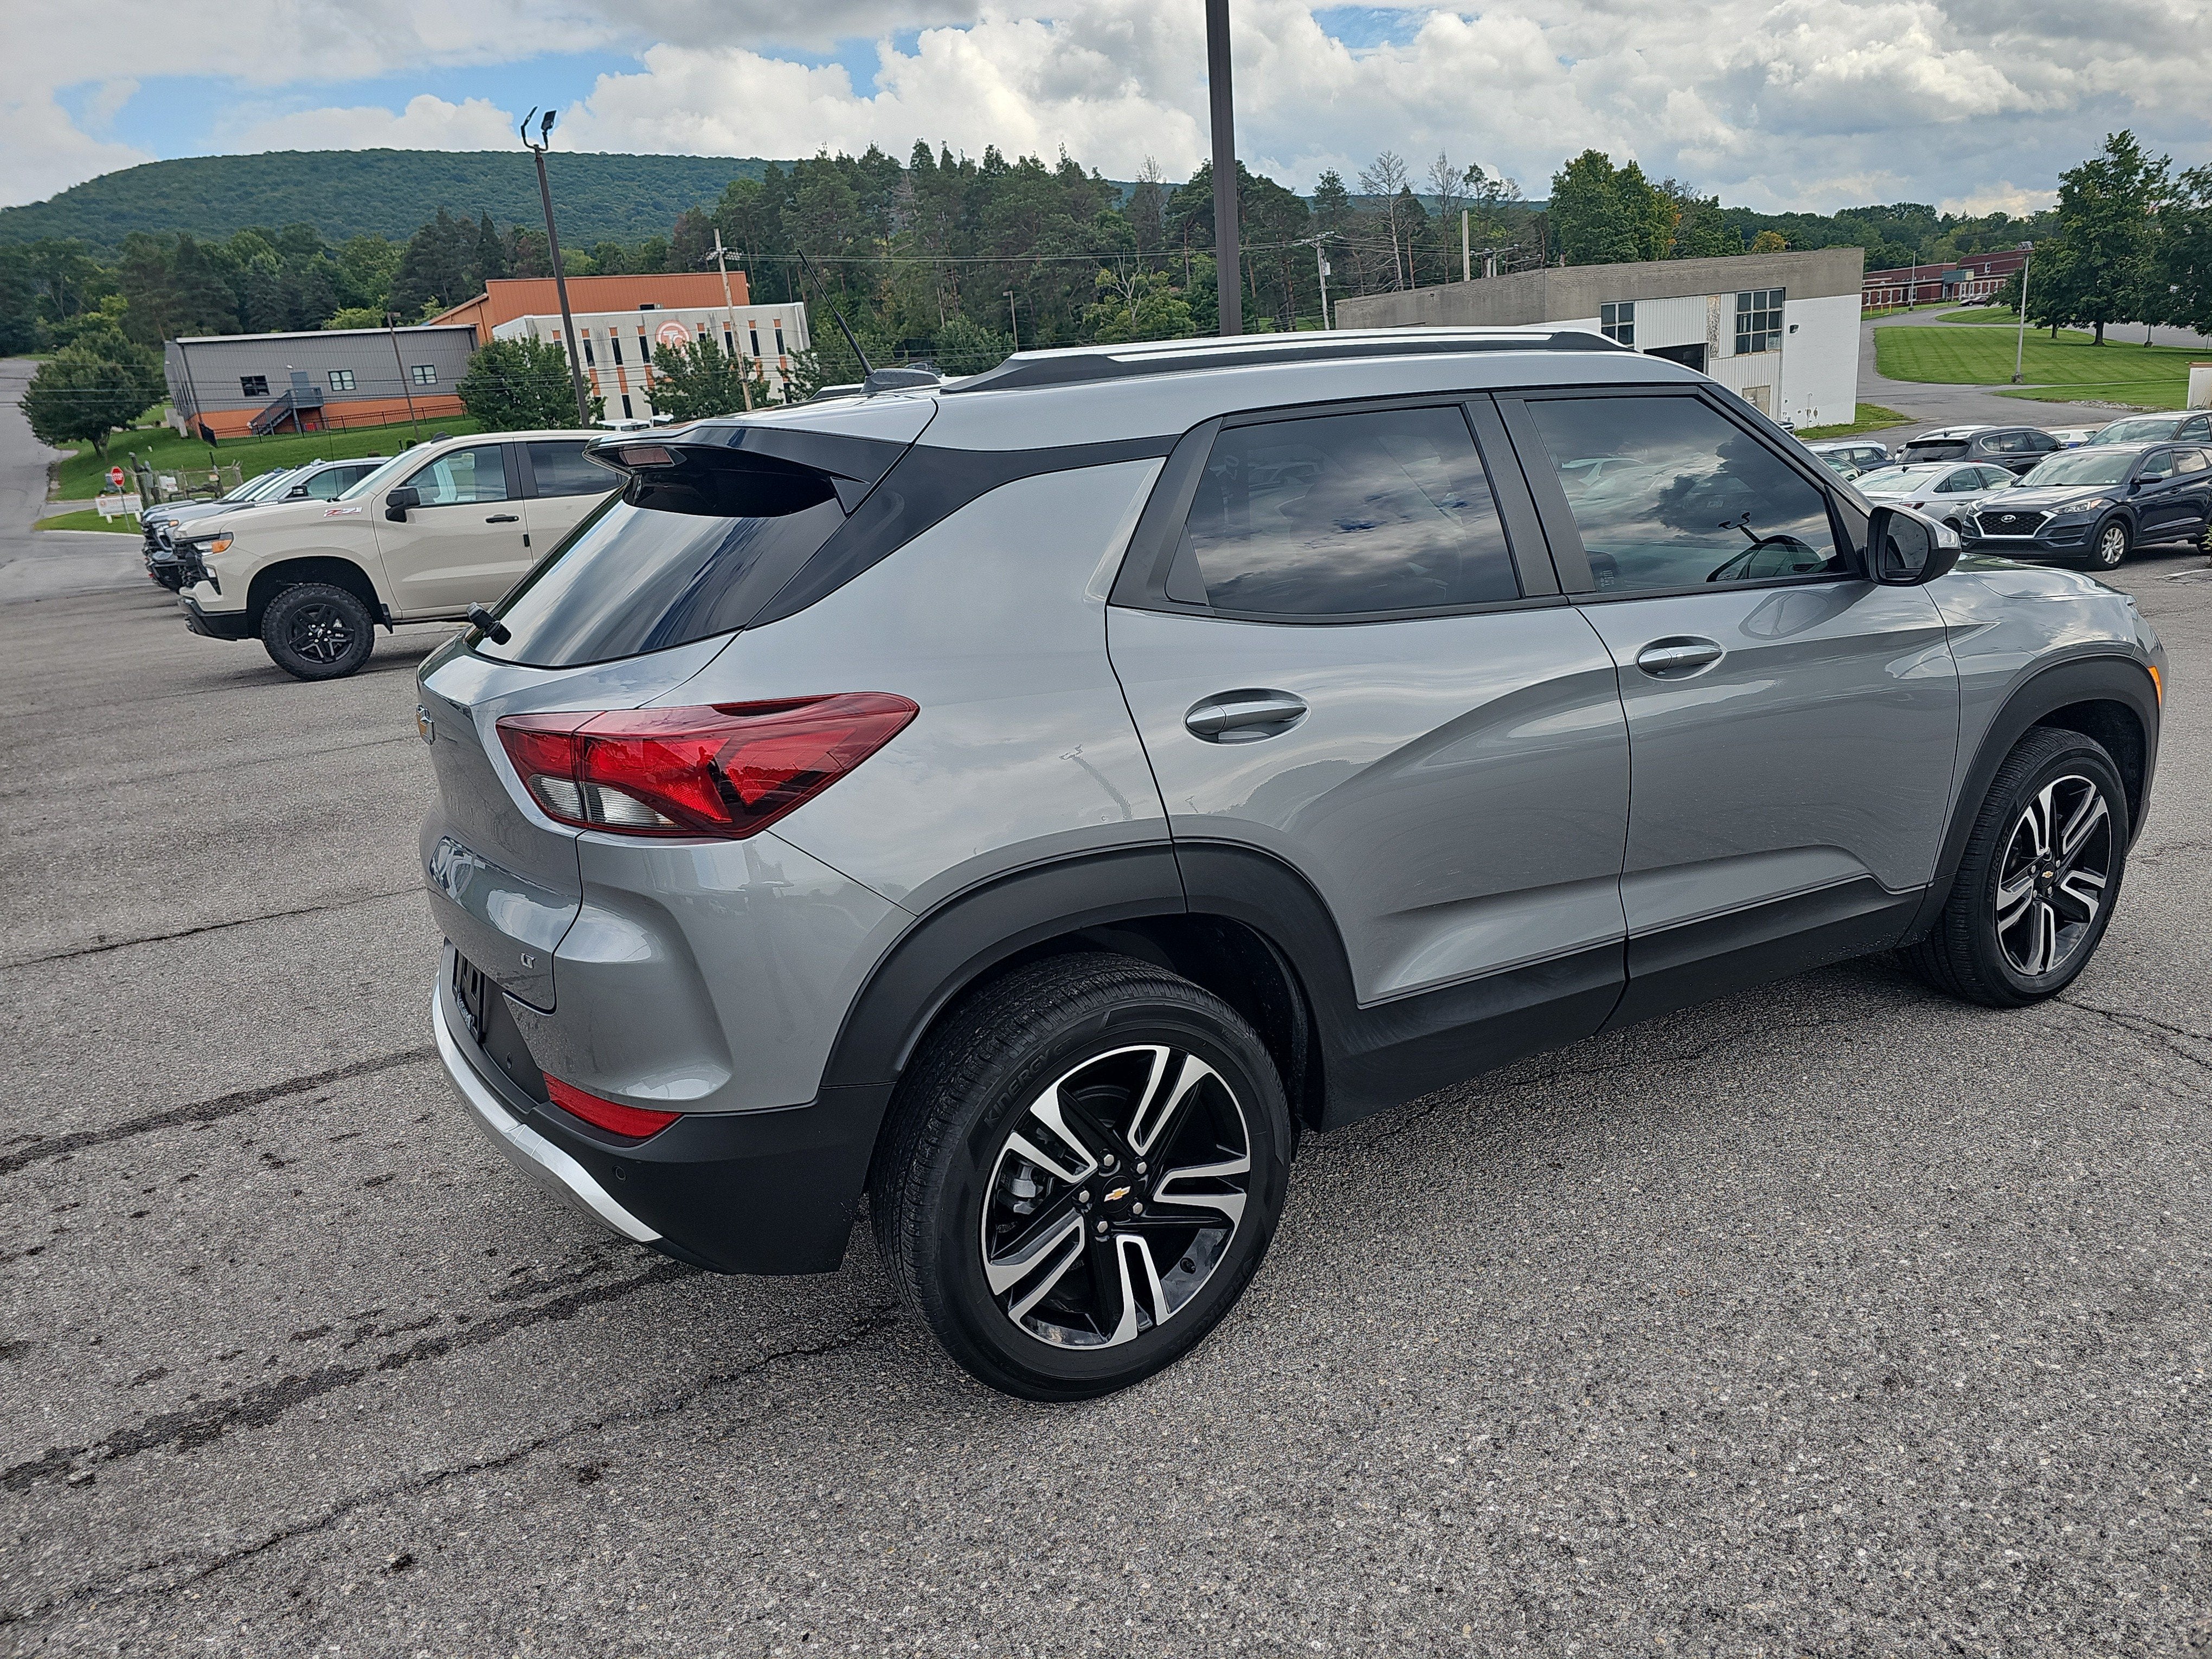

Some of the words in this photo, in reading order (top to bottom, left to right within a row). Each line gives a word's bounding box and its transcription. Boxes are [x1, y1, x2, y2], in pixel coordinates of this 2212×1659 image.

[112, 472, 124, 481] STOP
[324, 507, 363, 517] Z71
[520, 953, 536, 969] LT
[983, 1048, 1051, 1128] KINERGY
